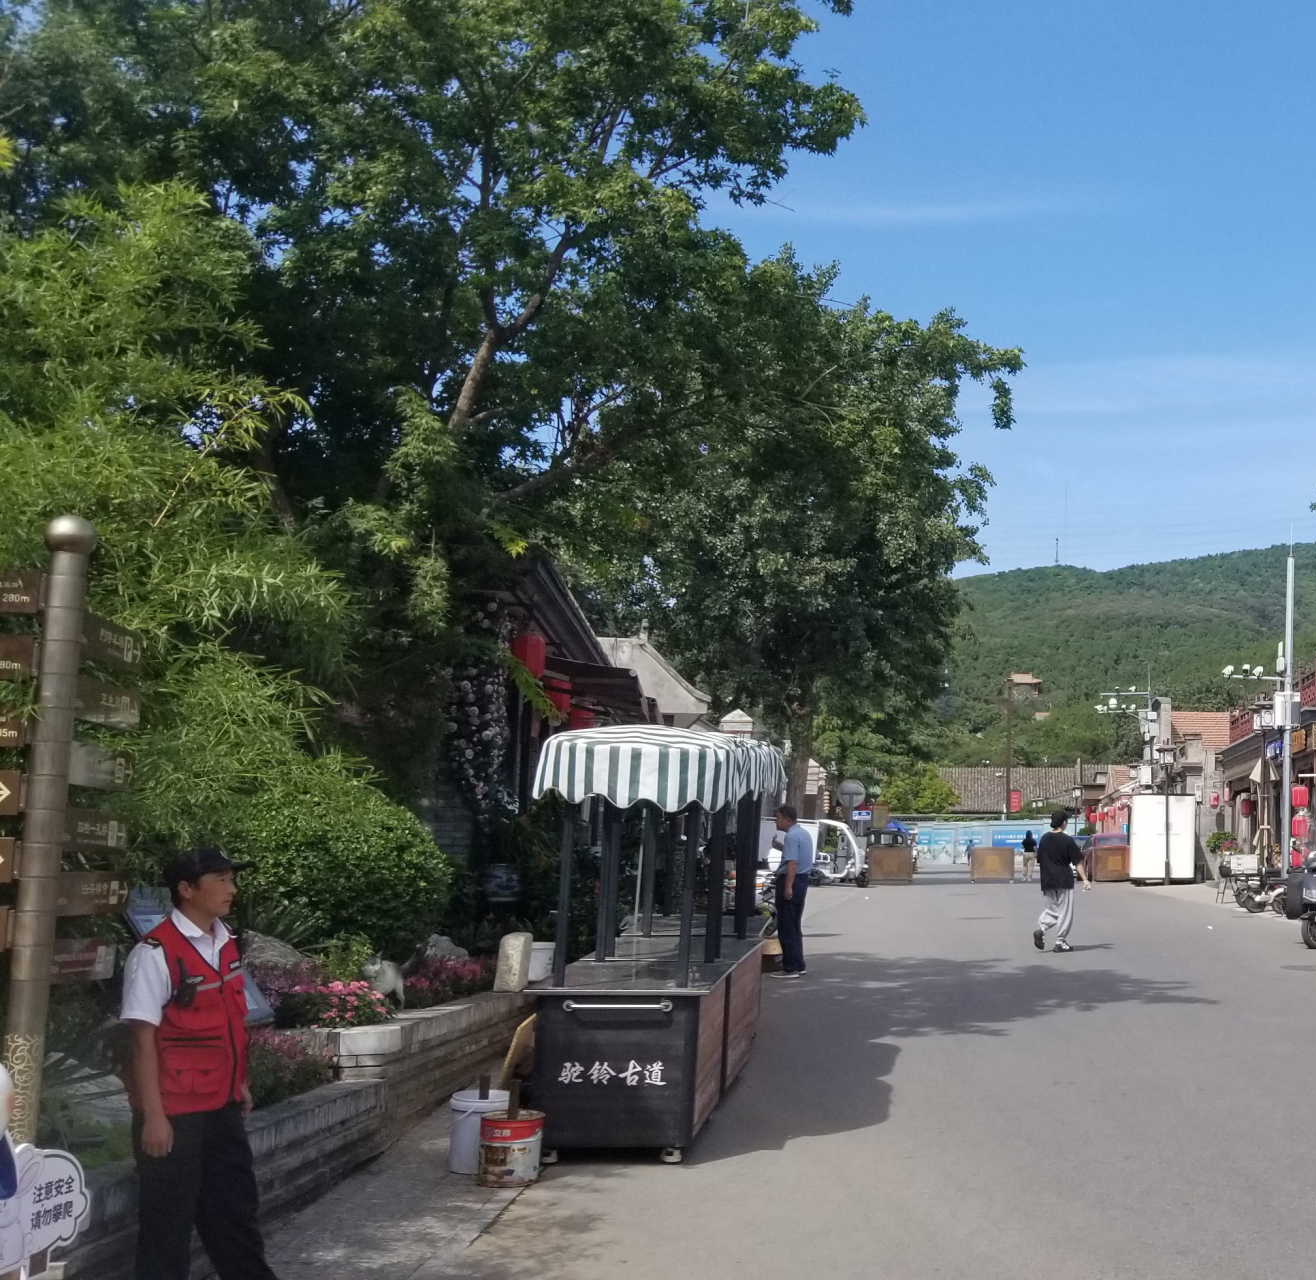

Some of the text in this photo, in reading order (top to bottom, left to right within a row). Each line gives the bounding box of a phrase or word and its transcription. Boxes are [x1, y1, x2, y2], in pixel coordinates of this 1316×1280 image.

[2, 593, 30, 604] 280m
[558, 1059, 667, 1087] 驼铃古道
[32, 1174, 75, 1204] 注意安全
[30, 1200, 73, 1231] 请勿攀爬
